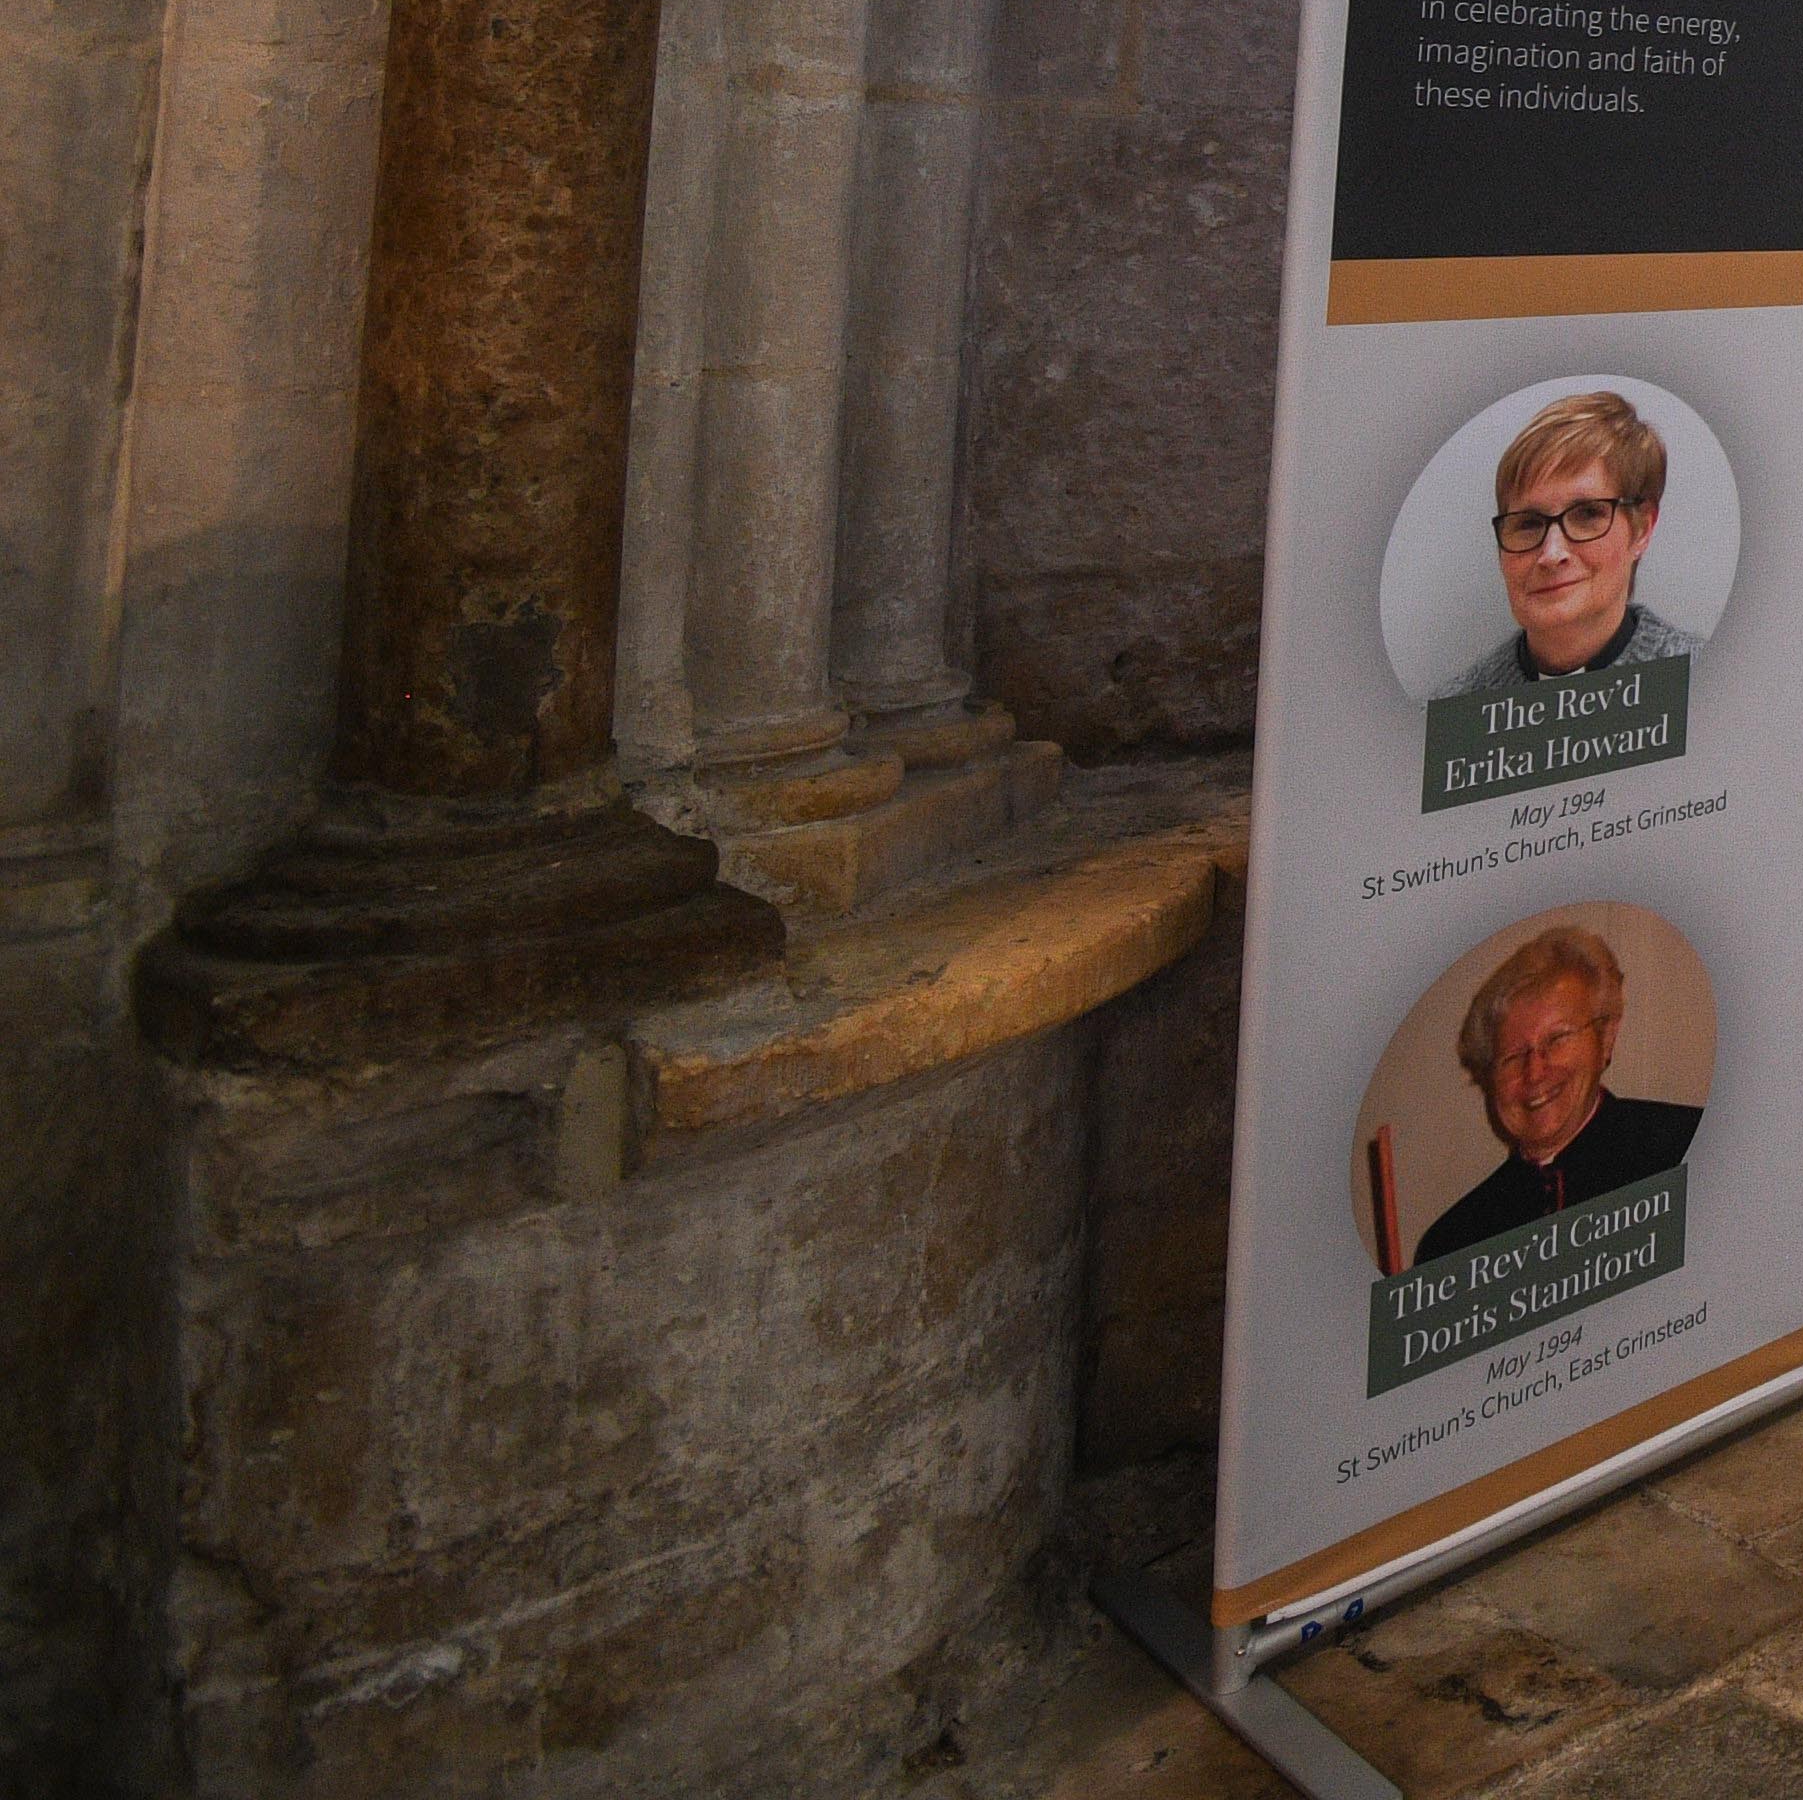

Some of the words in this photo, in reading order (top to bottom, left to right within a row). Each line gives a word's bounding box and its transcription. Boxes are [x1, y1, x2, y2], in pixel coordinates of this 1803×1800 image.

[1610, 5, 1650, 32] the
[1656, 14, 1741, 44] energy,
[1417, 38, 1580, 73] imagination
[1588, 45, 1635, 72] and
[1643, 47, 1695, 75] faith
[1702, 51, 1727, 76] of
[1414, 81, 1491, 108] these
[1499, 84, 1645, 113] individuals.
[1482, 700, 1545, 735] The
[1555, 674, 1641, 720] Rev'd
[1443, 746, 1535, 792] Erika
[1546, 715, 1669, 770] Howard
[1510, 806, 1555, 829] May
[1559, 788, 1606, 818] 1994
[1362, 877, 1385, 900] St
[1391, 848, 1498, 893] Swithun's
[1505, 829, 1585, 863] Church,
[1592, 819, 1632, 843] East
[1637, 790, 1728, 831] Grinstead
[1389, 1276, 1456, 1321] The
[1468, 1226, 1559, 1290] Rev'd
[1570, 1190, 1671, 1249] Canon
[1402, 1305, 1498, 1367] Doris
[1509, 1233, 1657, 1322] Staniford
